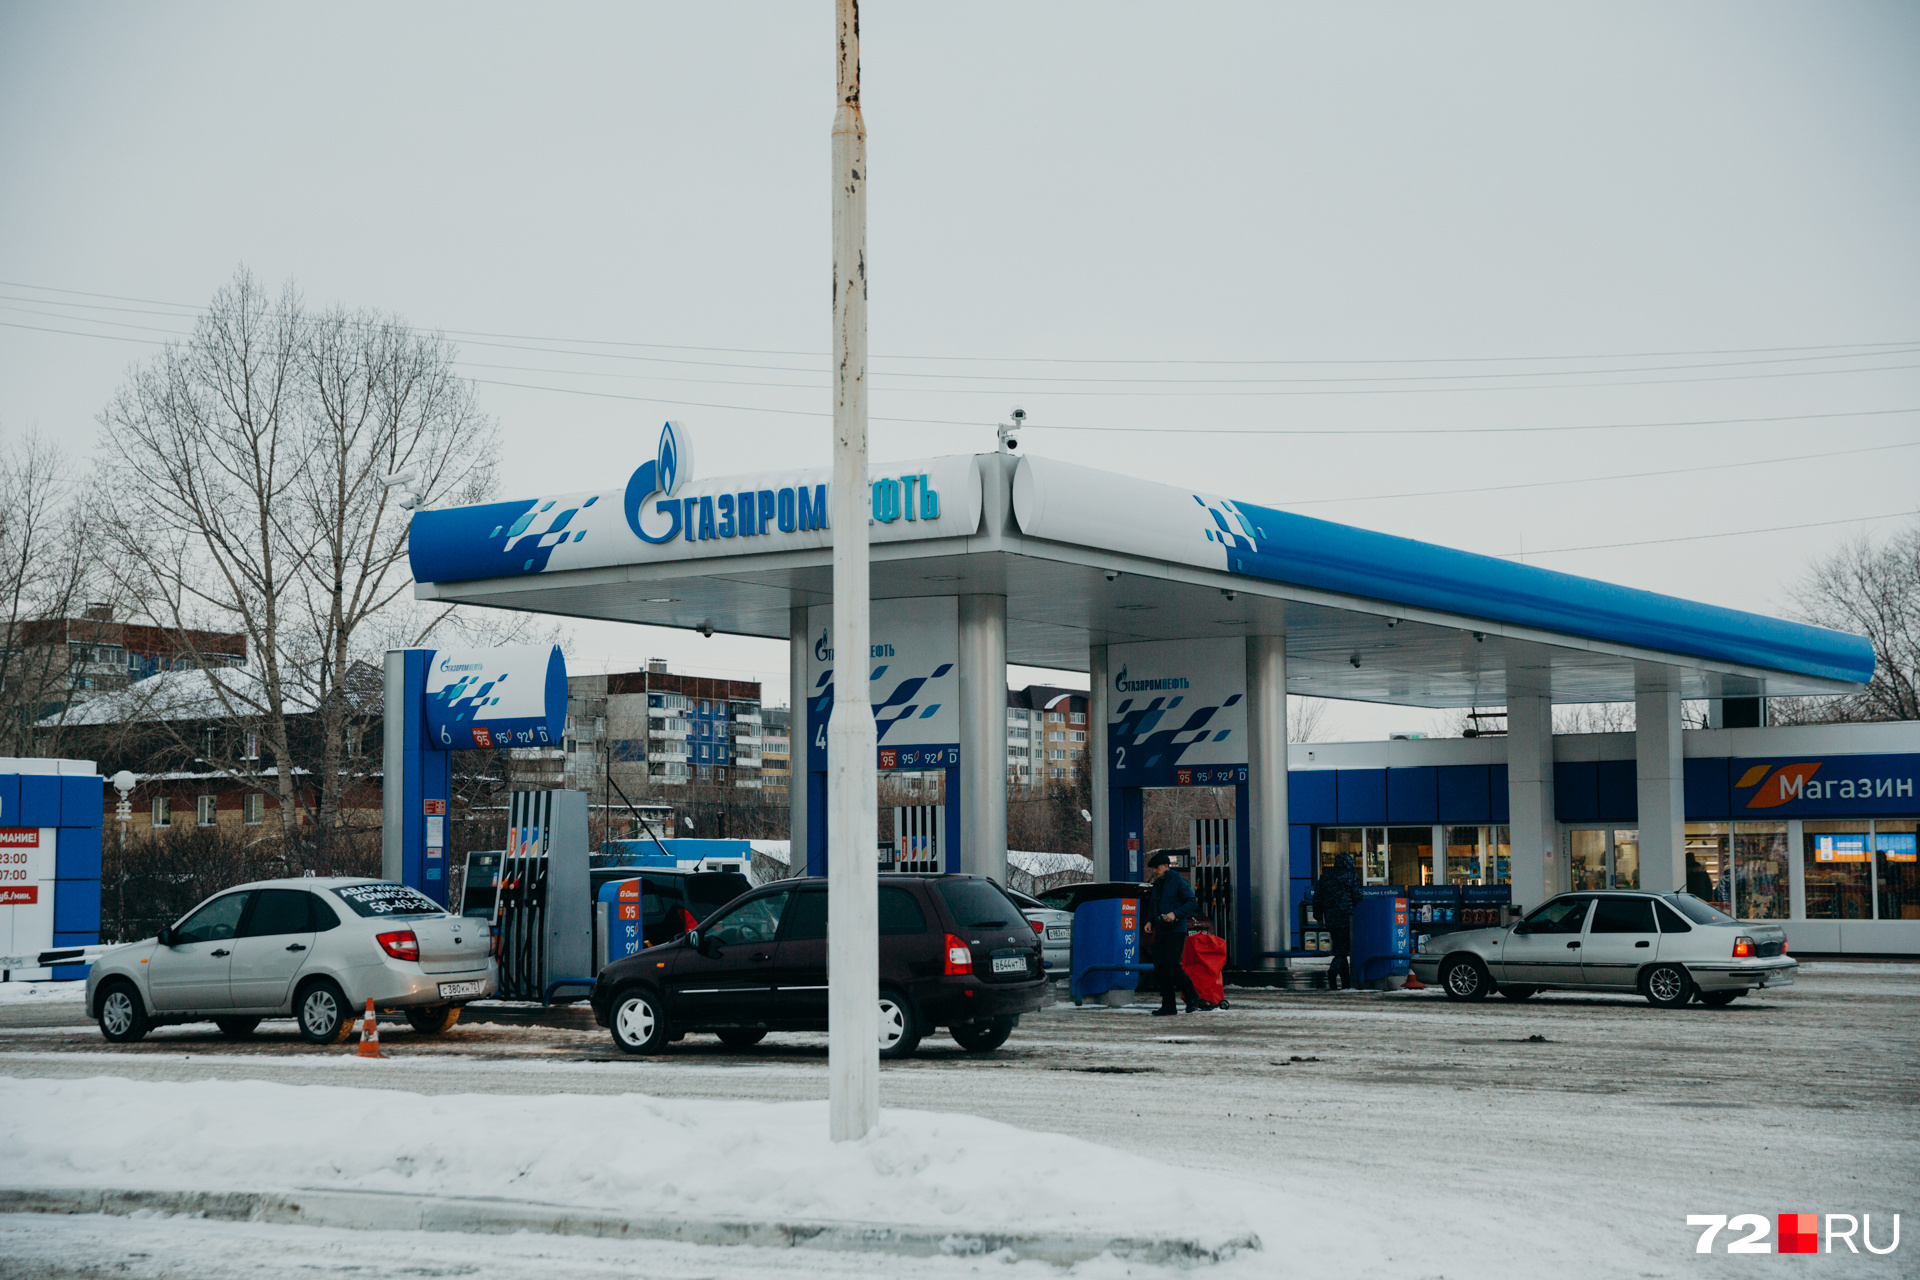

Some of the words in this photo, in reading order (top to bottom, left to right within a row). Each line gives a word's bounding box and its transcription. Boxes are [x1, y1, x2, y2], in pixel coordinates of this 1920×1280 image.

[684, 474, 940, 541] ГАЗПРОМФТЬ
[1127, 677, 1190, 692] ГАЗПРОМНЕФТЬ
[441, 724, 452, 745] 6
[476, 735, 490, 746] 95
[495, 732, 509, 744] 95
[517, 732, 530, 743] 92
[815, 724, 826, 750] 4
[882, 756, 894, 767] 95
[902, 753, 914, 764] 95
[924, 753, 937, 764] 92
[949, 753, 957, 763] D
[1116, 746, 1126, 770] 2
[1179, 774, 1190, 783] 95
[1197, 772, 1208, 782] 95
[1217, 772, 1228, 781] 92
[1239, 771, 1246, 780] D
[1779, 774, 1913, 800] Магазин
[625, 905, 636, 918] 95
[1124, 917, 1133, 929] 95
[1397, 914, 1404, 924] 95
[625, 925, 635, 938] 95
[1124, 934, 1132, 945] 95
[625, 942, 635, 954] 92
[1124, 948, 1132, 959] 92
